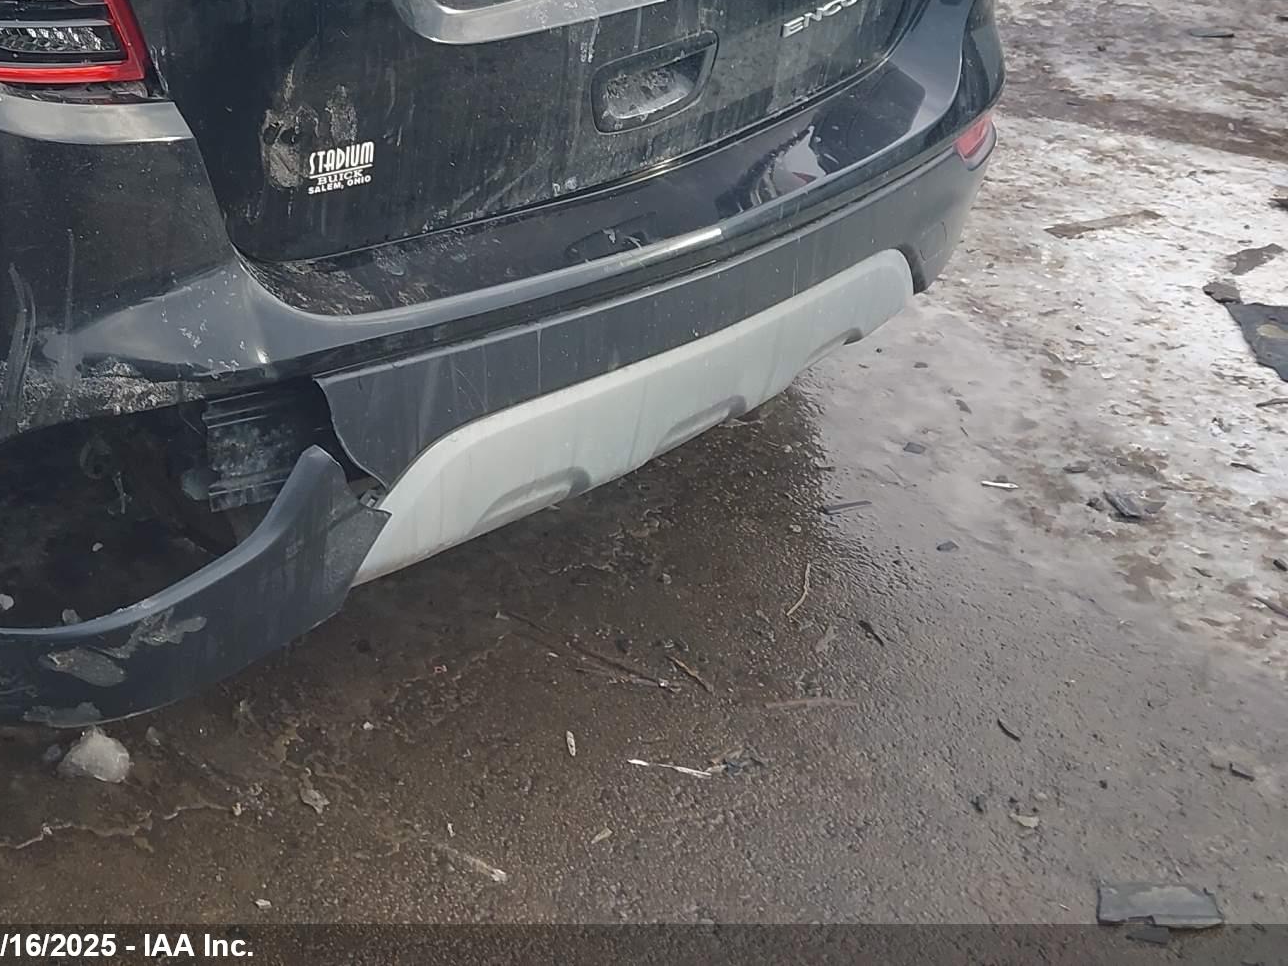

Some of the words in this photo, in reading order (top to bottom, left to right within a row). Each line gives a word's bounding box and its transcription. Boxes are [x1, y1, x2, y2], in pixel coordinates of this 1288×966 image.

[309, 141, 374, 175] STADIUM
[308, 182, 344, 194] SALEM,
[347, 175, 372, 186] OHIO
[317, 169, 363, 185] BUICK
